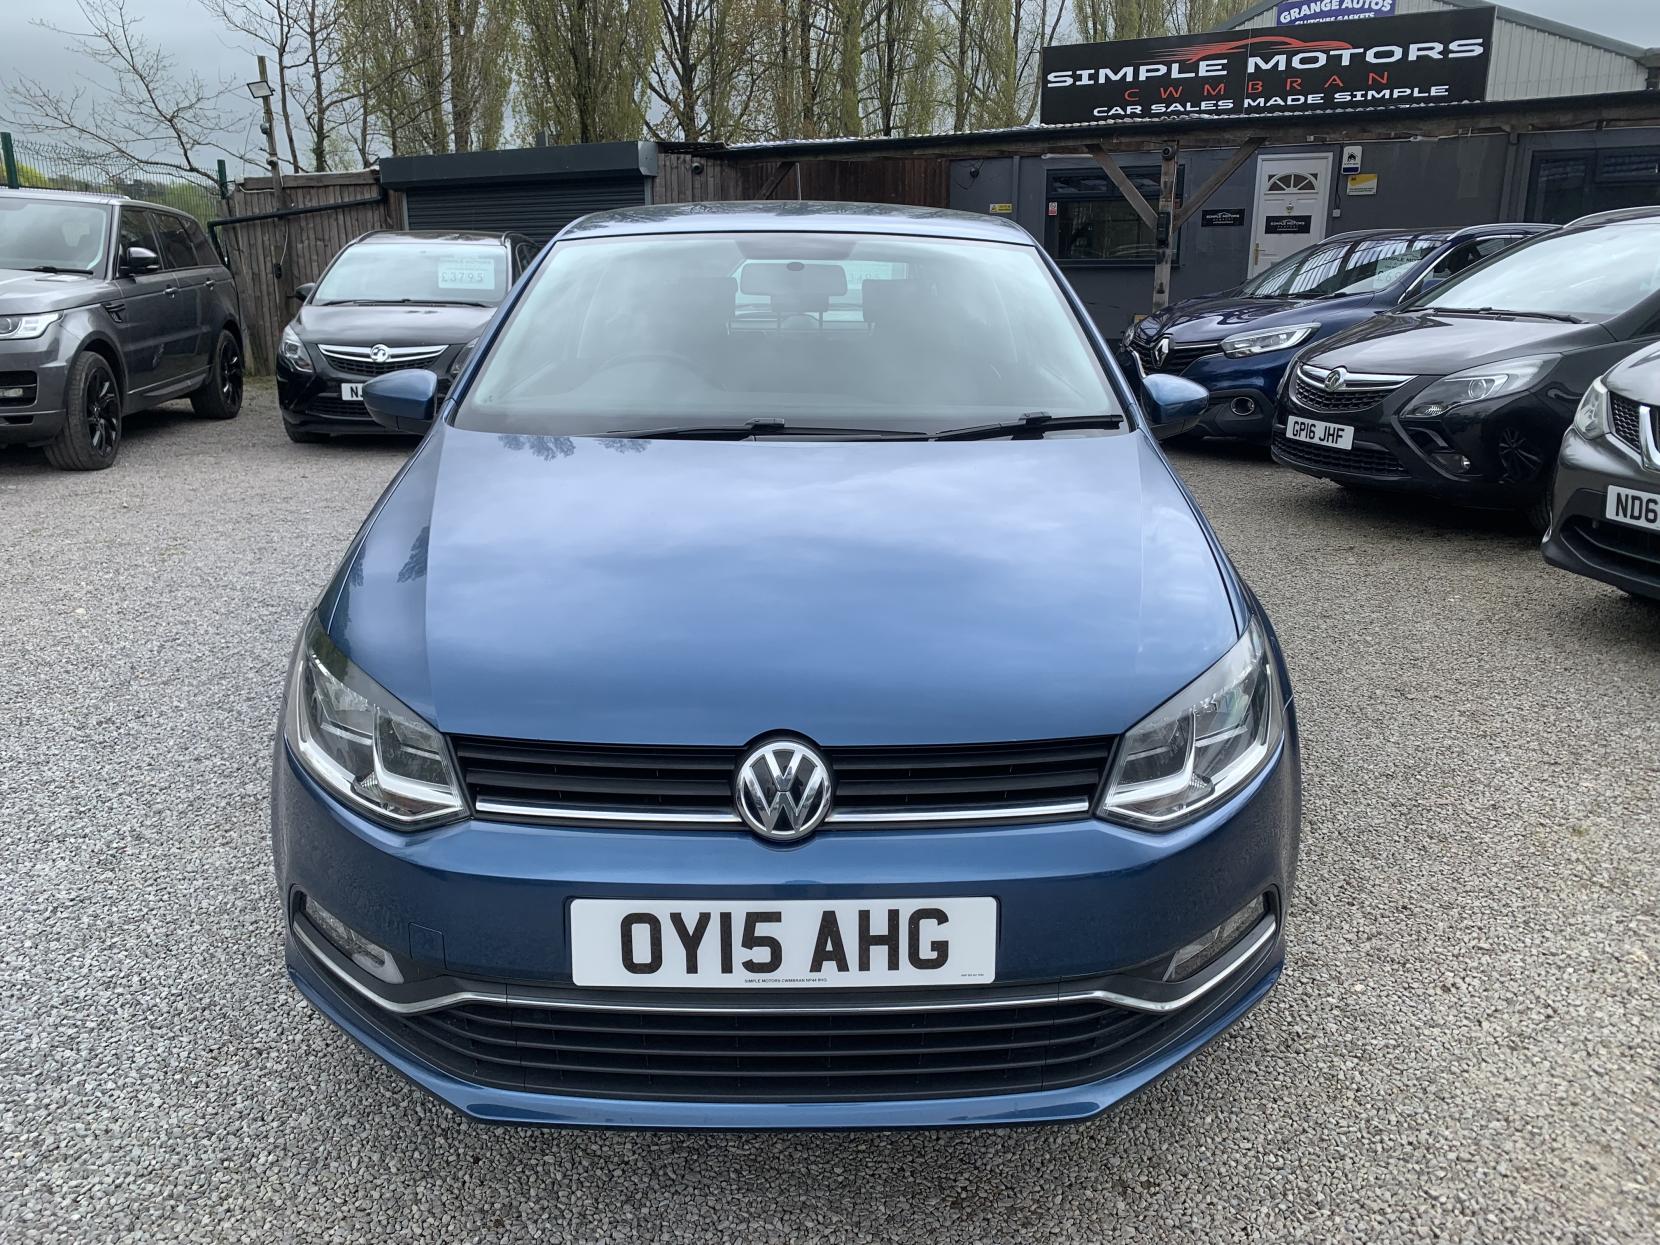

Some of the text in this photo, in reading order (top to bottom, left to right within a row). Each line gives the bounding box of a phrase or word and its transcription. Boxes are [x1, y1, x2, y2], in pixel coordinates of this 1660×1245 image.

[1280, 0, 1392, 23] GRANGE AUTOS
[1047, 38, 1484, 87] SIMPLE MOTORS
[1093, 85, 1449, 117] CAR SALES MADE SIMPLE
[1293, 421, 1345, 445] GP16 JHF
[1615, 492, 1659, 524] ND6
[620, 907, 950, 974] OY15 AHG
